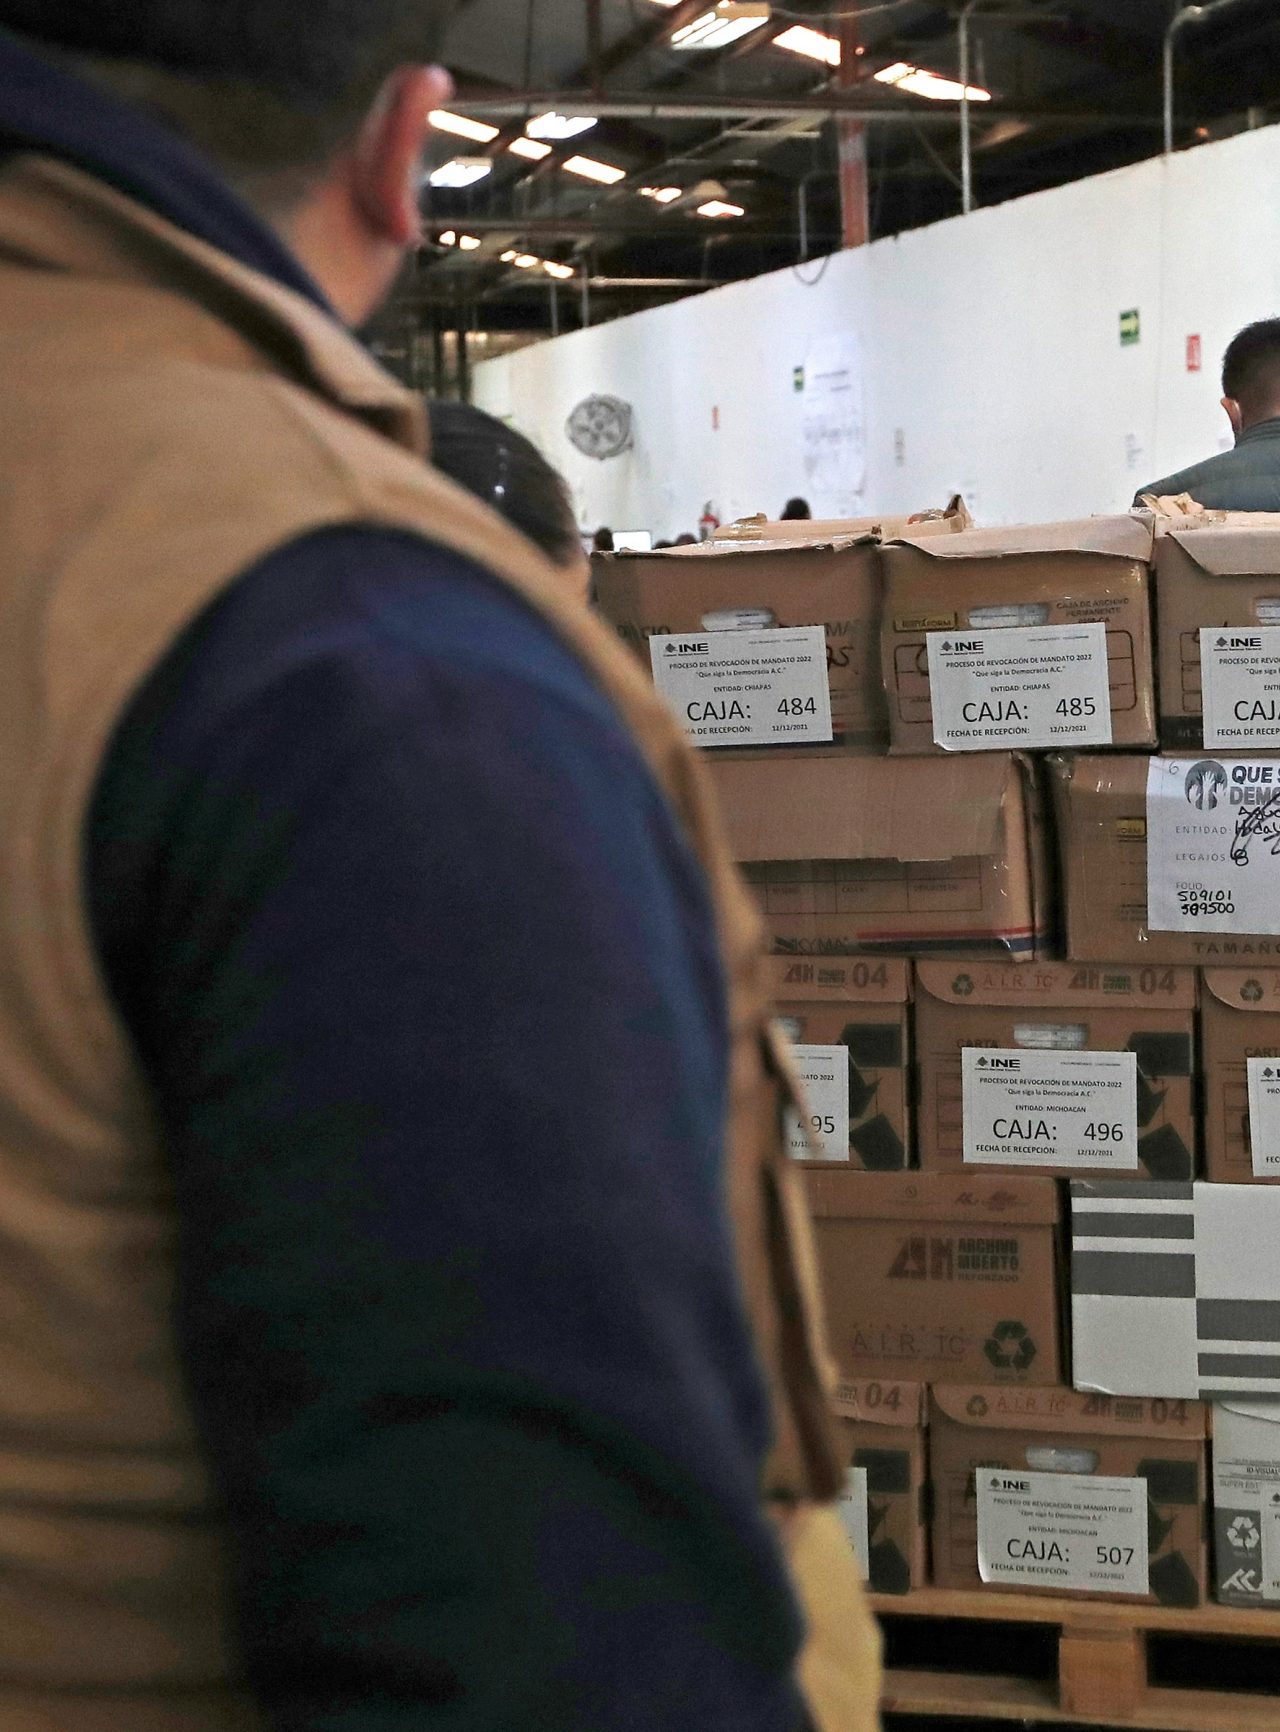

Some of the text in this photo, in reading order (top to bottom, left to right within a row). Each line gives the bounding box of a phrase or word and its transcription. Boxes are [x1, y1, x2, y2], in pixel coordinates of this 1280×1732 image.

[679, 643, 708, 652] INE
[955, 641, 983, 651] INE
[1231, 638, 1261, 646] INE
[733, 668, 769, 676] Democracia
[687, 697, 817, 721] CAJA: 484
[962, 697, 1095, 722] CAJA: 485
[1231, 766, 1273, 785] QUE
[852, 963, 888, 989] 04
[1140, 967, 1178, 995] 04
[991, 1059, 1020, 1068] INE
[993, 1119, 1123, 1141] CAJA: 496
[1003, 1480, 1030, 1490] INE
[1007, 1539, 1134, 1565] CAJA: 507
